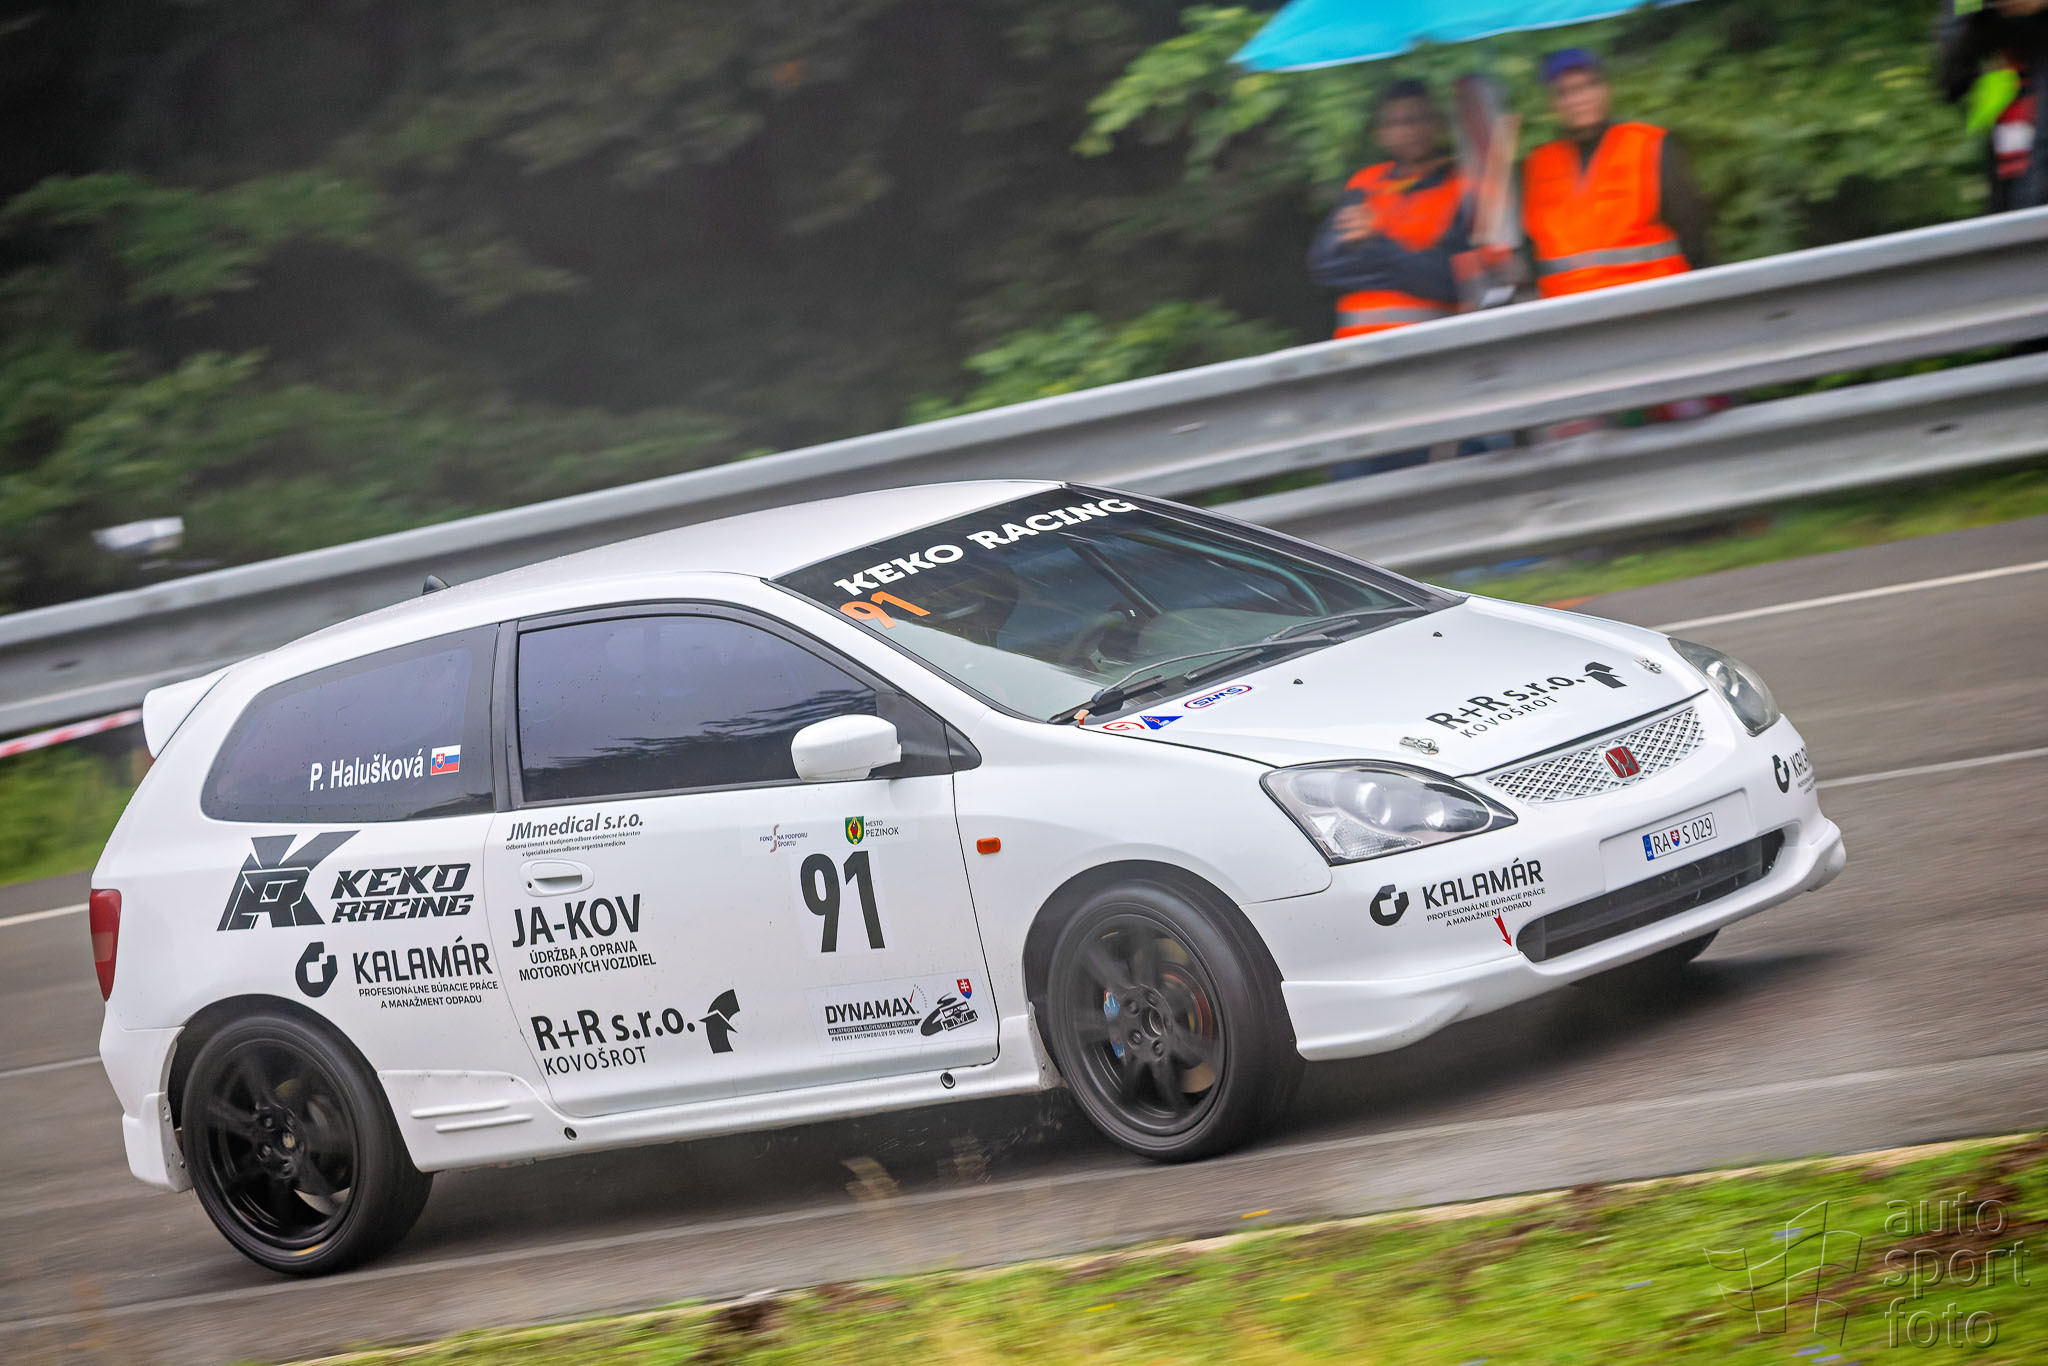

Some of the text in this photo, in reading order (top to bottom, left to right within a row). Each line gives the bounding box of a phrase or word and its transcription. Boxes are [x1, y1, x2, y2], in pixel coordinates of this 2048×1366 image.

[833, 498, 1140, 597] KEKO RACING
[839, 590, 931, 630] 91
[1425, 676, 1586, 730] R+R s.r.o.
[1460, 695, 1559, 738] KOVOŠROT
[309, 748, 424, 792] P. Halušková
[506, 812, 644, 841] JMmedical s.r.o.
[865, 827, 900, 838] PEZINOK
[1653, 832, 1672, 855] RA
[330, 862, 472, 900] KEKO
[1422, 857, 1544, 910] KALAMÁR
[331, 894, 475, 924] RACING
[800, 850, 886, 953] 91
[1426, 887, 1546, 922] PROFESIONÁLNE BÚRACIE PRÁCE
[1446, 900, 1532, 927] A MANAŽMENT ODPADU
[512, 893, 641, 948] JA-KOV
[352, 935, 494, 985] KALAMÁR
[518, 953, 657, 982] MOTOROVÝCH VOZIDIEL
[529, 940, 638, 965] ÚDRŽBA A OPRAVA
[358, 979, 499, 997] PROFESIONÁLNE BÚRACIE PRÁCE
[380, 995, 483, 1009] A MANAŽMENT ODPADU
[825, 995, 917, 1025] DYNAMAX
[530, 1007, 696, 1052] R+R s.r.o.
[543, 1046, 647, 1076] KOVOŠROT
